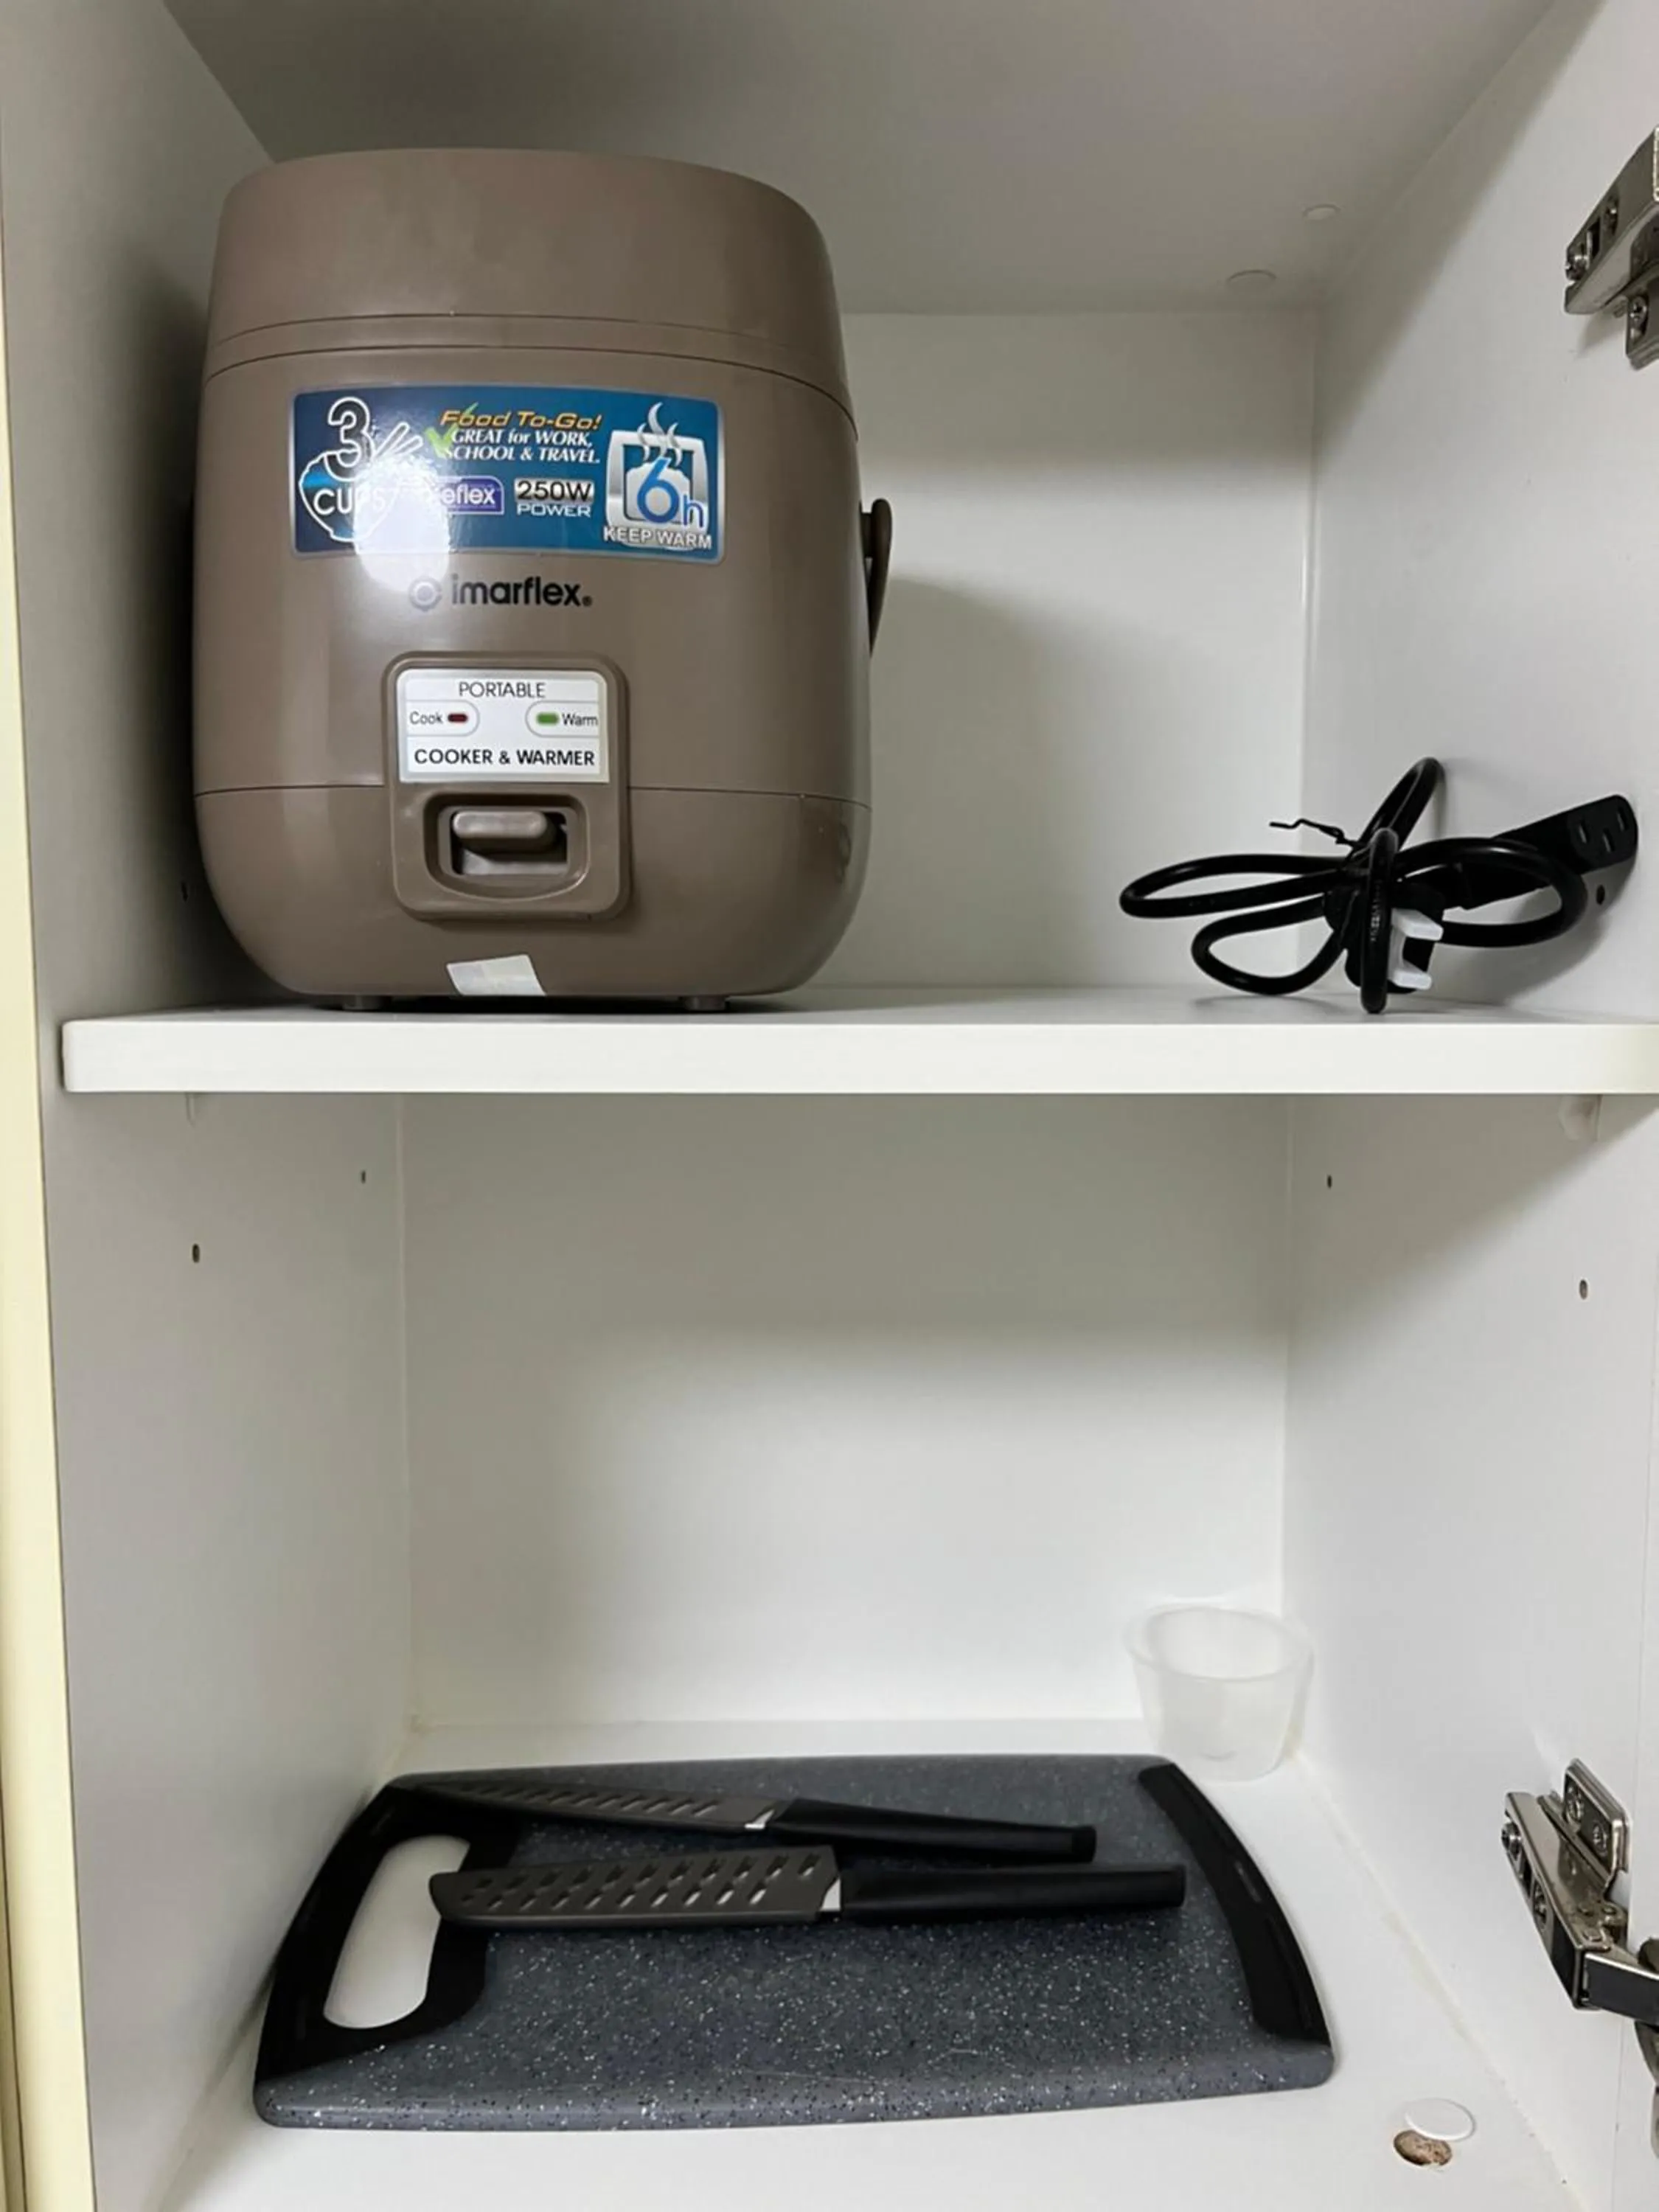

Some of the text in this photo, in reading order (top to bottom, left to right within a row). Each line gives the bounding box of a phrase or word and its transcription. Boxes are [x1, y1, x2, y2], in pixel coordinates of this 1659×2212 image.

[440, 411, 602, 430] Food To-Go!
[326, 397, 375, 481] 3
[452, 428, 504, 444] GREAT
[508, 428, 530, 444] for
[520, 447, 532, 460] &
[540, 448, 600, 464] TRAVEL.
[518, 481, 592, 502] 250W
[517, 503, 591, 517] POWER
[603, 526, 712, 549] KEEP WARM
[459, 681, 546, 698] PORTABLE
[409, 711, 444, 726] Cook
[562, 713, 599, 726] Warm
[414, 748, 595, 766] COOKER & WARMER
